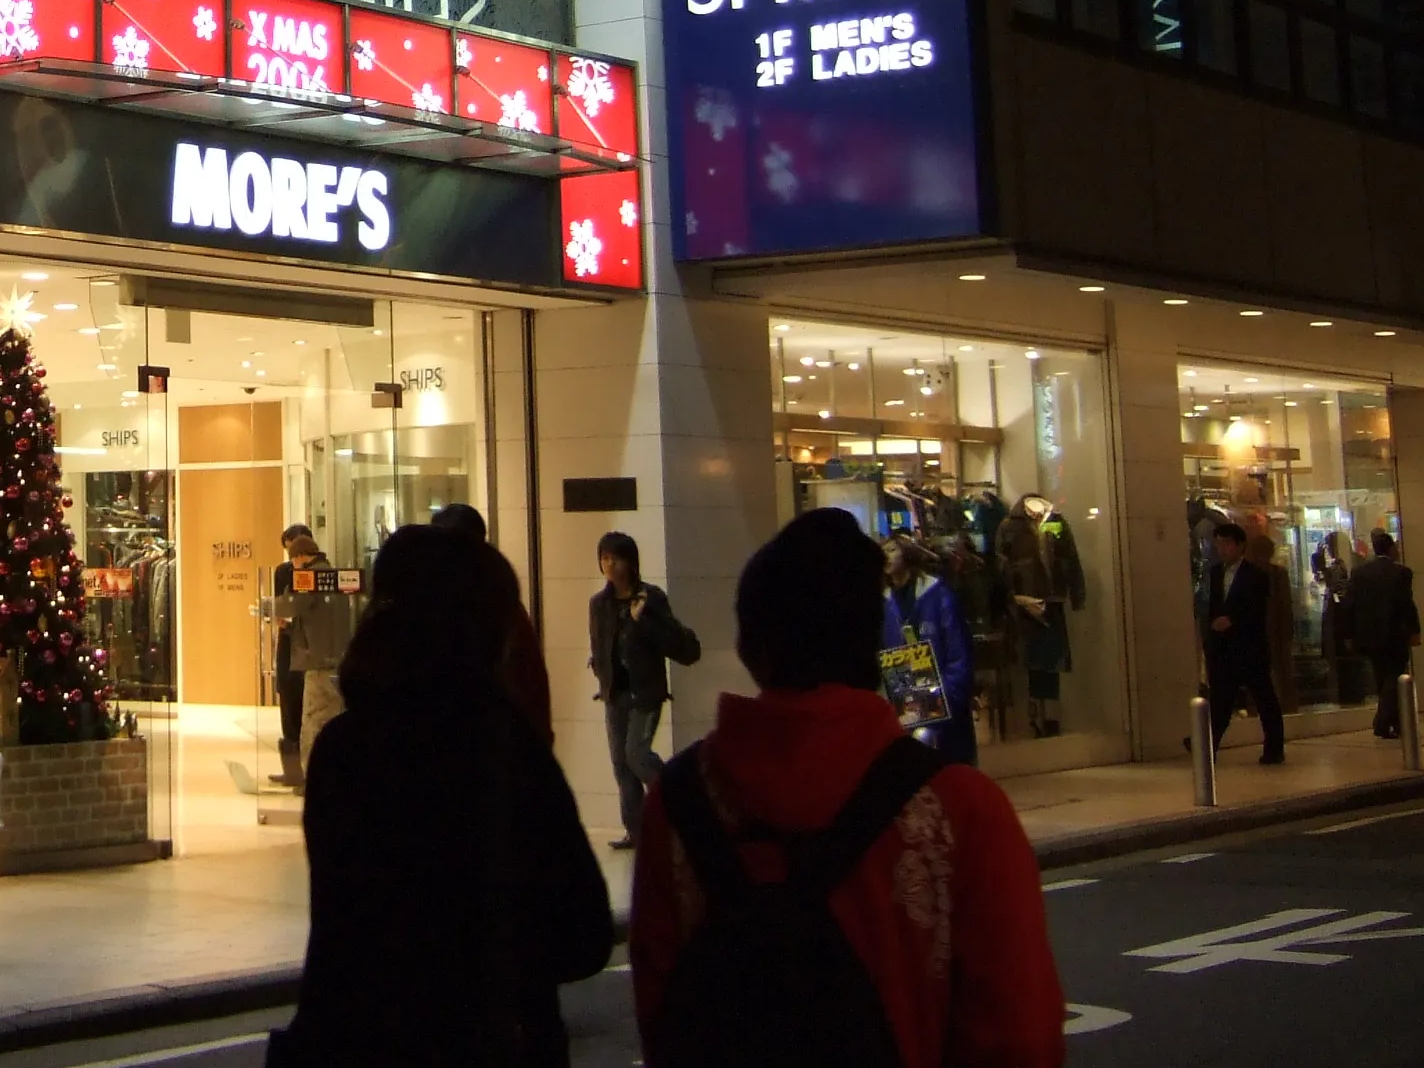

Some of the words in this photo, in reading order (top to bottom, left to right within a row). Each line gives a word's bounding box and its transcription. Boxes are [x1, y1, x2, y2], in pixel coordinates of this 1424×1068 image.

[754, 29, 793, 58] 1F
[809, 12, 915, 52] MEN'S
[755, 58, 795, 88] 2F
[811, 40, 933, 81] LADIES
[171, 142, 390, 251] MORE'S
[400, 367, 444, 392] SHIPS
[101, 429, 140, 447] SHIPS
[212, 541, 253, 559] SHIPS
[880, 642, 931, 669] カラオケ
